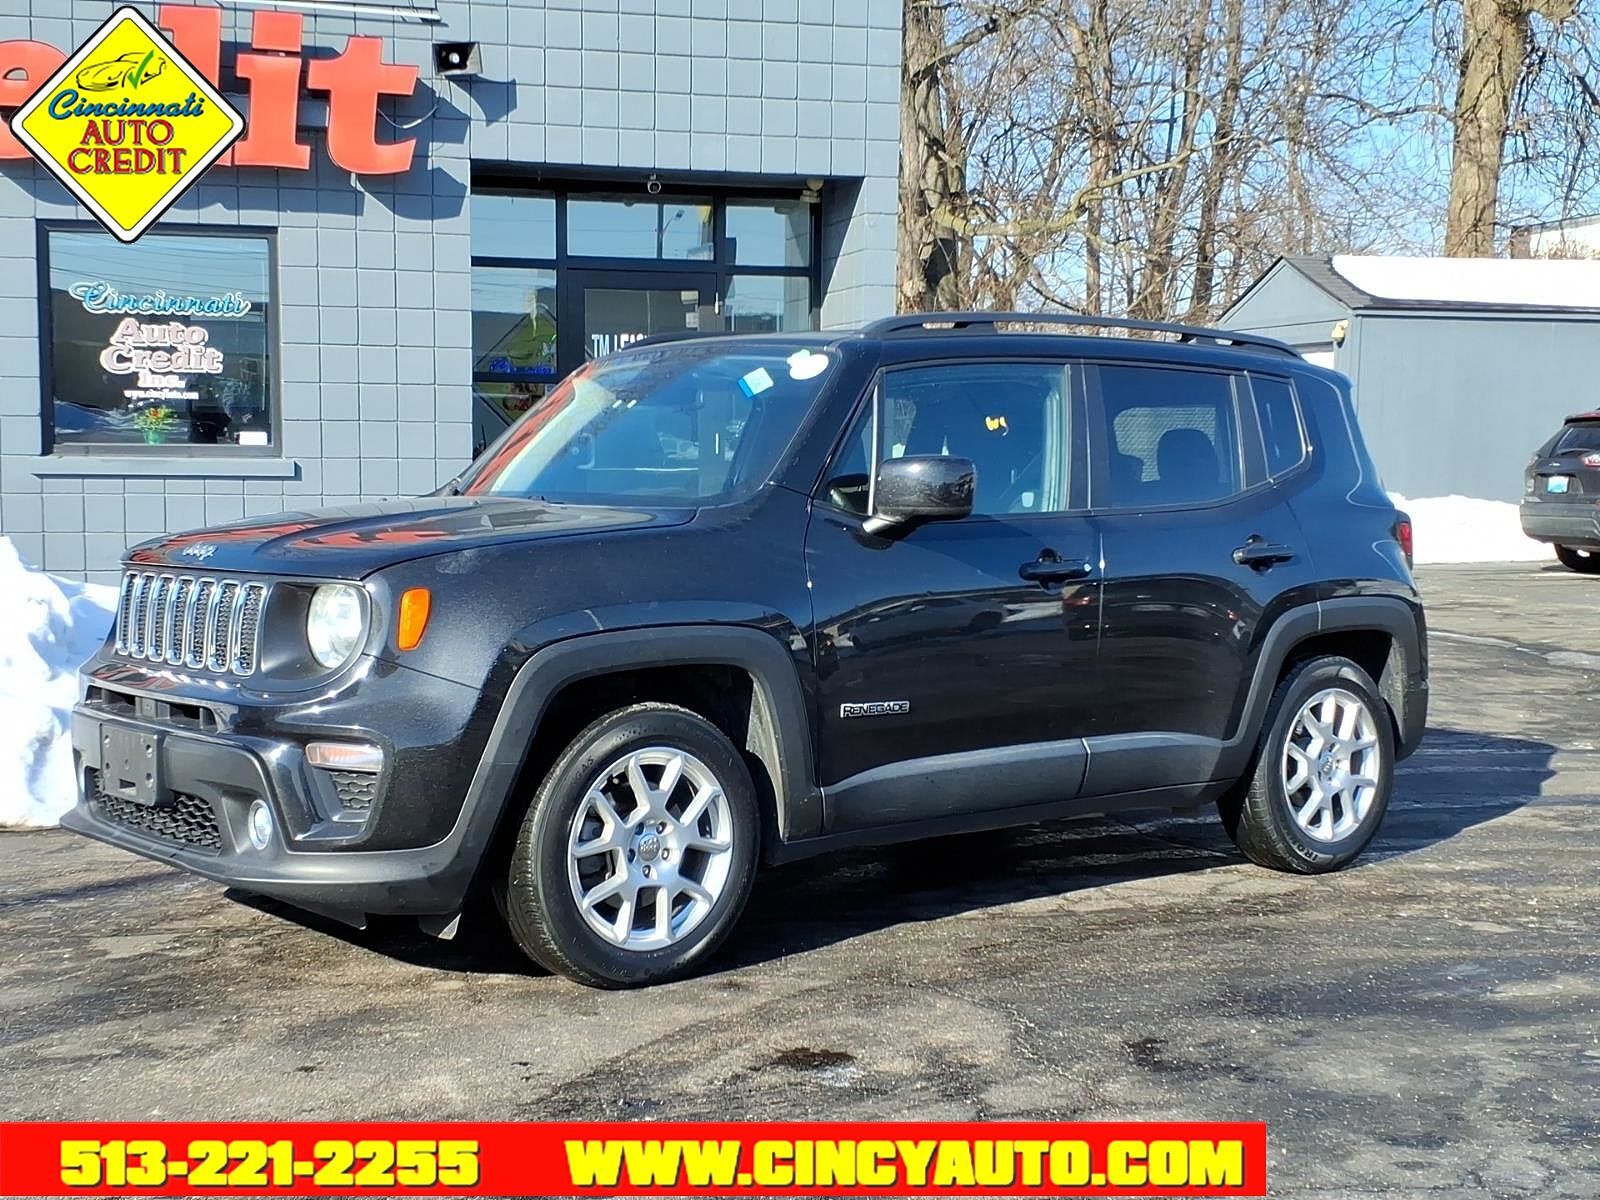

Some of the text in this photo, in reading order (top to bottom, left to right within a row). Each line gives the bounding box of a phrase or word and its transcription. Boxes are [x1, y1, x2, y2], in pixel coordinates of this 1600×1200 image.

[69, 281, 251, 317] Cincinnati
[110, 318, 208, 347] Auto
[99, 346, 224, 373] Credit
[842, 702, 909, 717] RENEGADE
